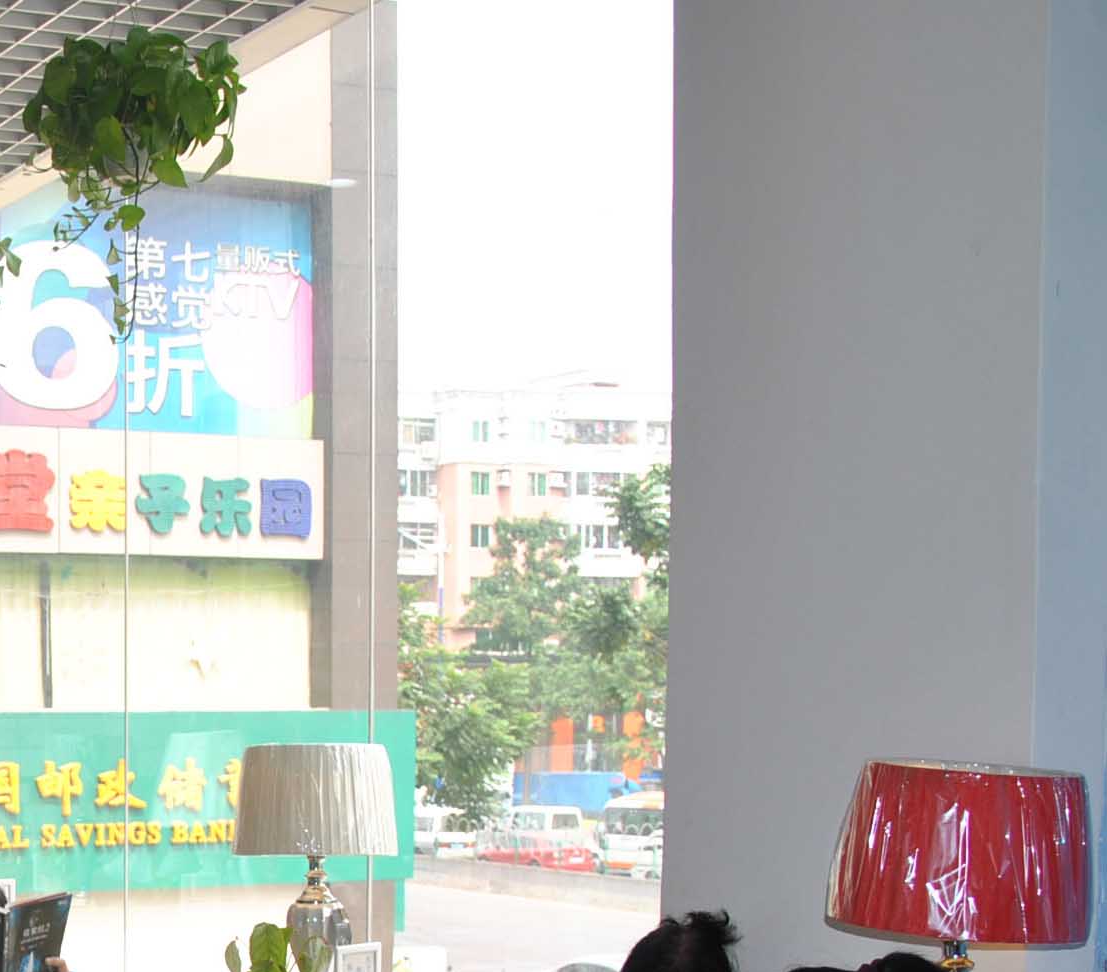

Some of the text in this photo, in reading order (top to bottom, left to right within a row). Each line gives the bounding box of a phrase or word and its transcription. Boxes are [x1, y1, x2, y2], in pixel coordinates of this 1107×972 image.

[127, 328, 207, 418] 折
[41, 821, 161, 848] SAVINGS
[170, 818, 236, 844] BAN
